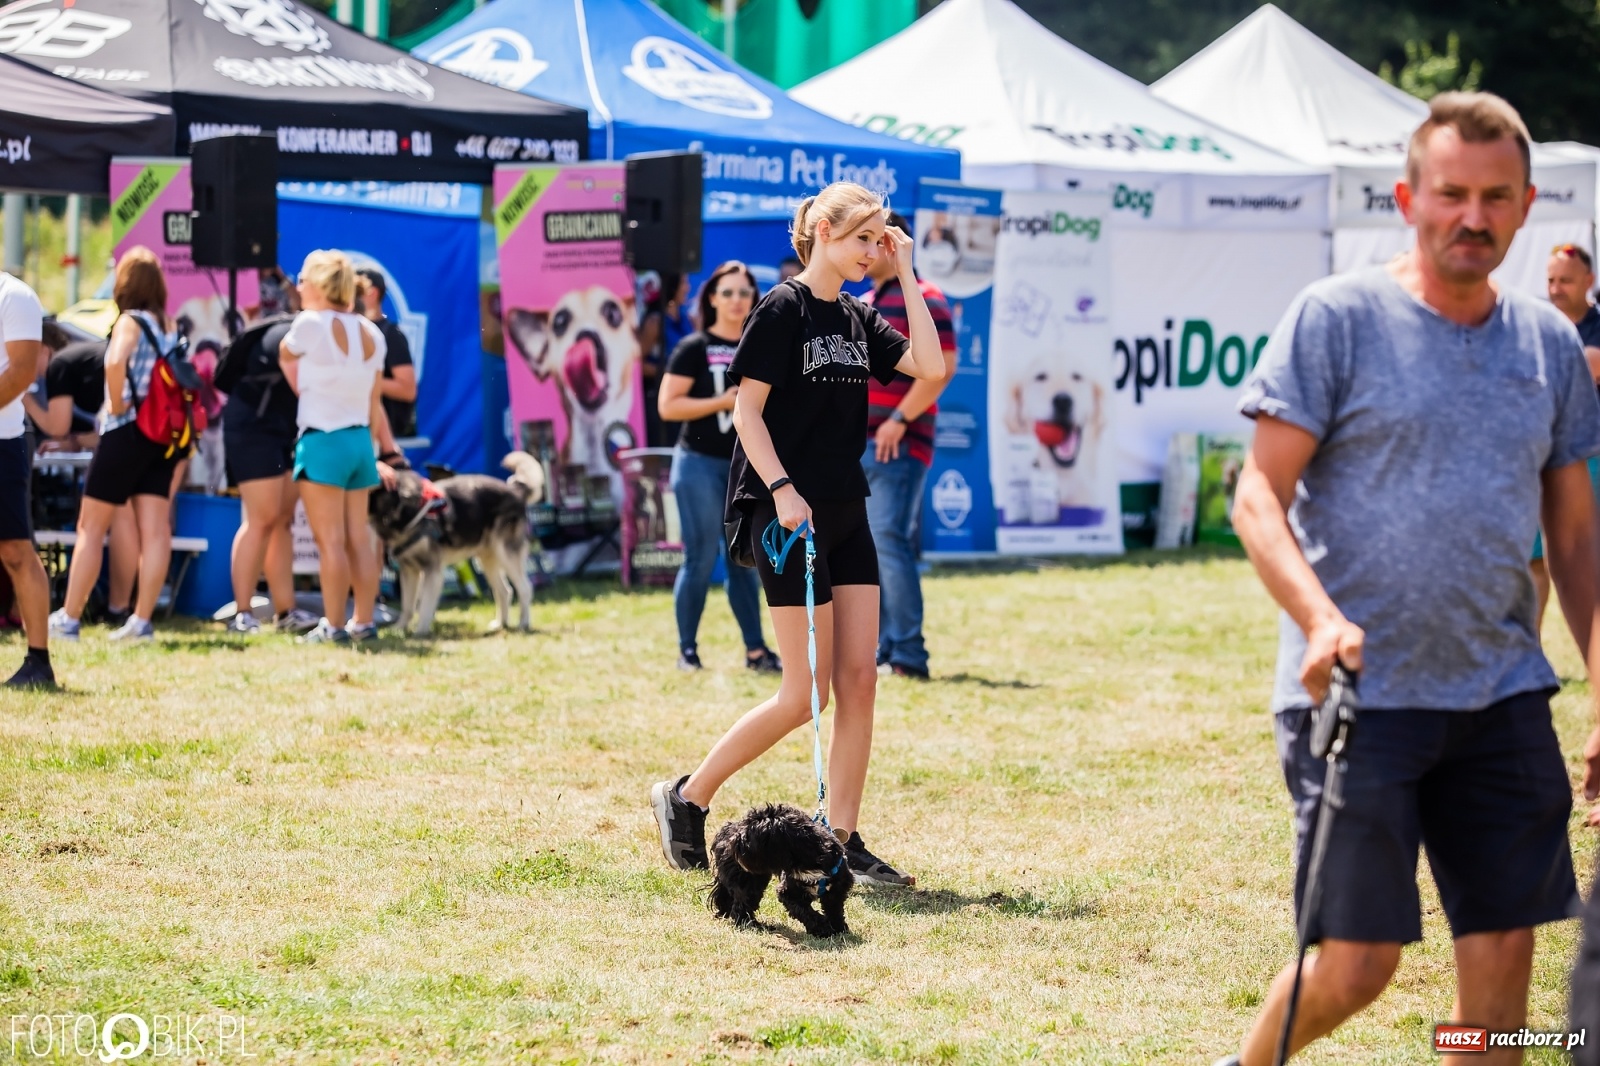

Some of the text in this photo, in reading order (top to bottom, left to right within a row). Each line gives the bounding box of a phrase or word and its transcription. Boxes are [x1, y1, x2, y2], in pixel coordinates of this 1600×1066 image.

[411, 130, 432, 157] DJ
[789, 149, 826, 188] Pet
[803, 336, 831, 375] LOS
